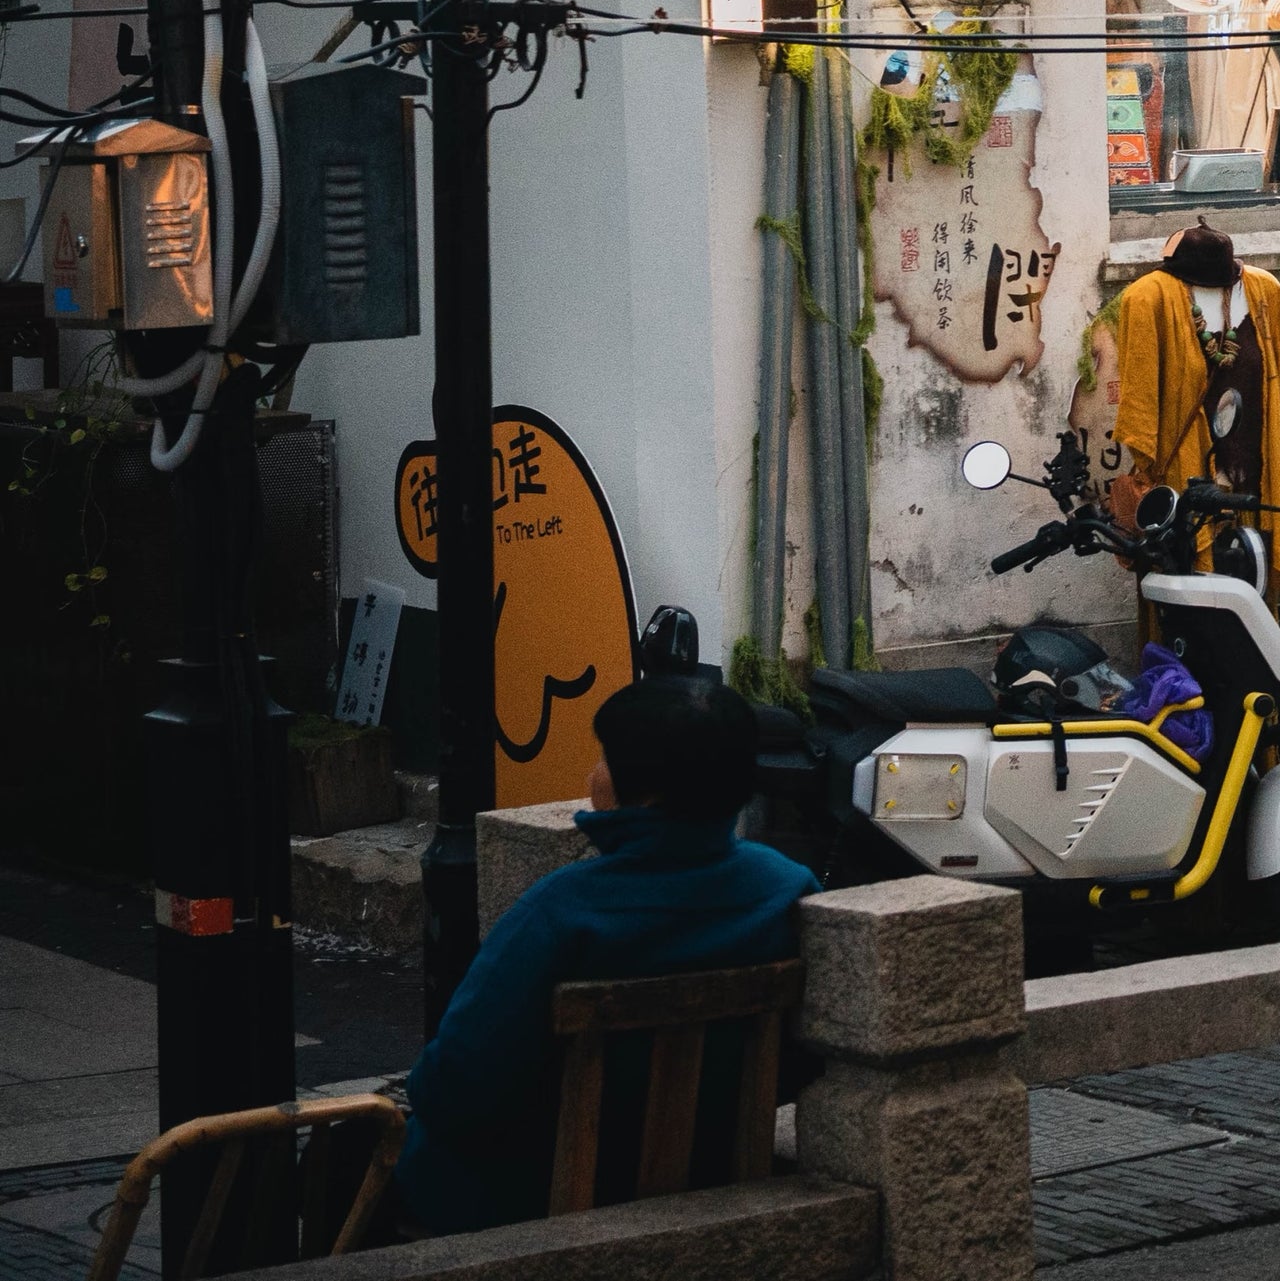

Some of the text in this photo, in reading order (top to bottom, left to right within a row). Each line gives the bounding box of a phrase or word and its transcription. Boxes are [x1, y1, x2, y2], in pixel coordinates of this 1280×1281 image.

[496, 516, 563, 544] To The Left
